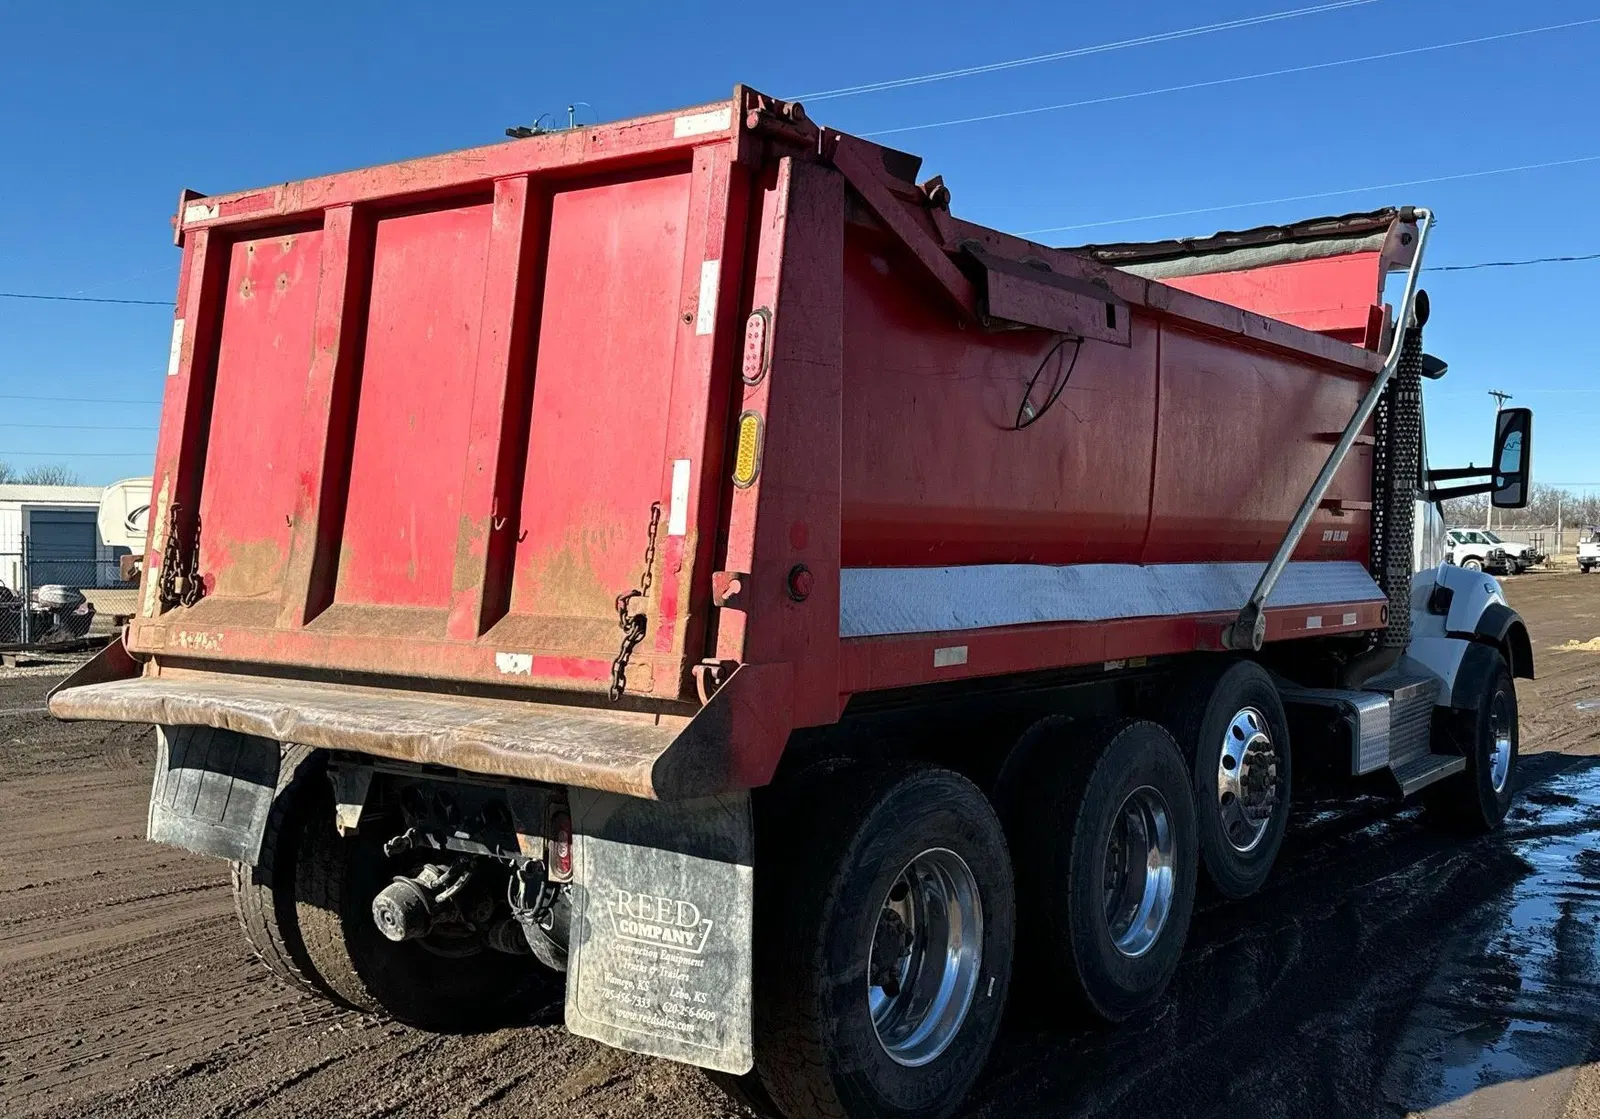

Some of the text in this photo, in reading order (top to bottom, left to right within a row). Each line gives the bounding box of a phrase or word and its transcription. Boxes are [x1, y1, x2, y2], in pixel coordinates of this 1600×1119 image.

[616, 888, 700, 927] REED
[620, 919, 696, 946] COMPANY
[611, 939, 704, 967] Construction Equipment
[604, 971, 650, 992] Wamego, KS
[623, 957, 648, 973] Trucks
[660, 965, 690, 982] Trailers
[601, 987, 651, 1009] 785-456-7333
[669, 986, 708, 1004] Lebo, KS
[614, 1008, 695, 1033] www.reedsales.com
[662, 1001, 716, 1022] 620-256-6609
